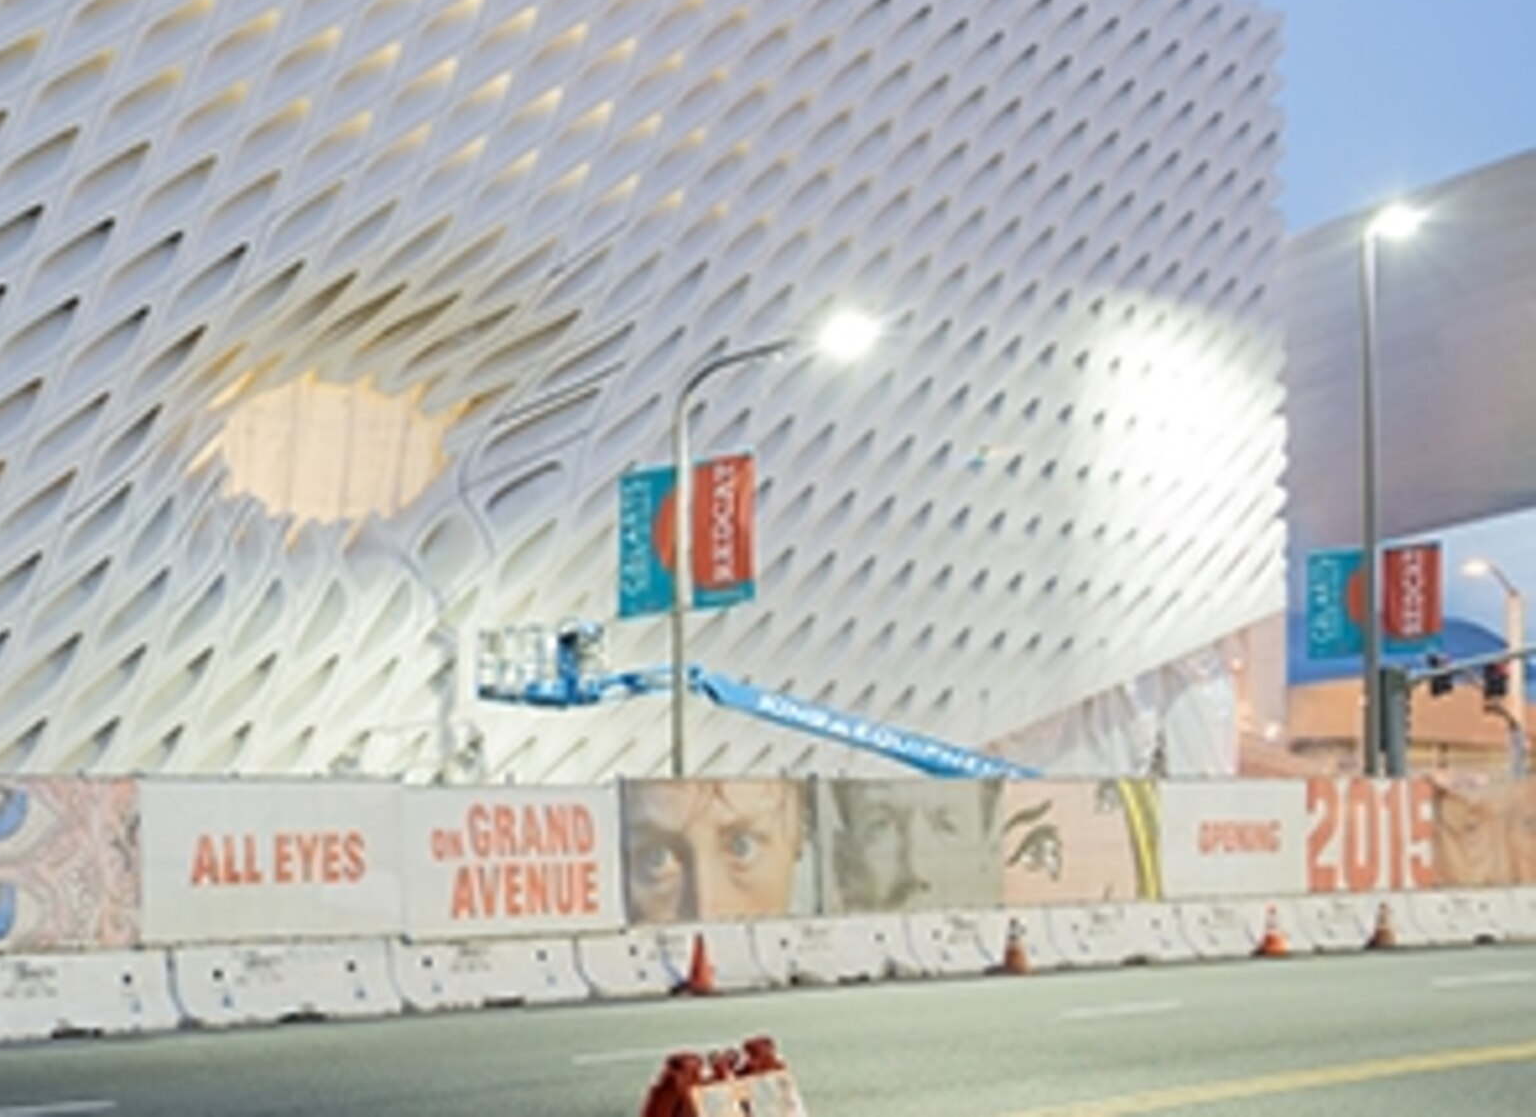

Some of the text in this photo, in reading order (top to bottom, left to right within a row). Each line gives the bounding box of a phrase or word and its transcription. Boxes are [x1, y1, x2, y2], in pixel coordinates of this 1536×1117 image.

[189, 829, 367, 887] ALL EYES
[431, 803, 596, 862] ON GRAND
[1198, 776, 1437, 893] OPENING 2015
[450, 860, 600, 920] AVENUE
